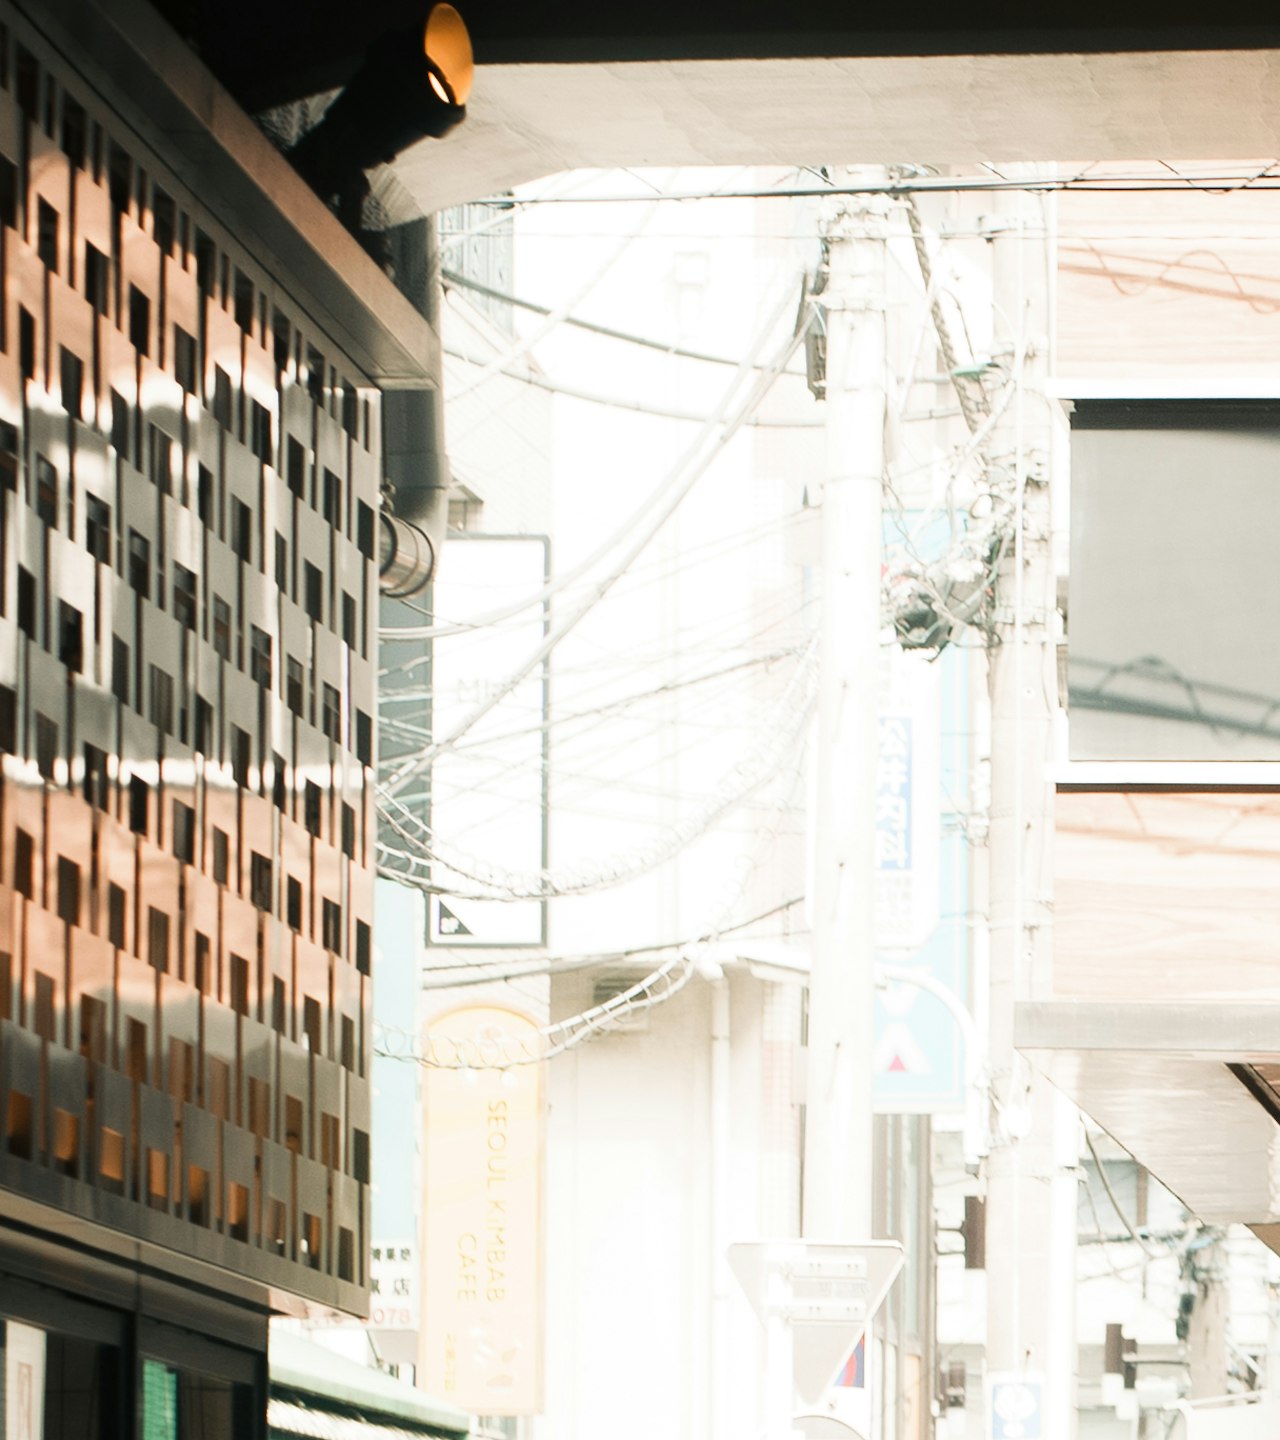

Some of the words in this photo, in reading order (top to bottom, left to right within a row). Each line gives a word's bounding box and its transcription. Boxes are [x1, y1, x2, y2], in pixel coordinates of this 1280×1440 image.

[487, 1100, 509, 1189] SEOUL
[457, 1232, 479, 1303] CAFE
[486, 1199, 509, 1304] KIMBAB
